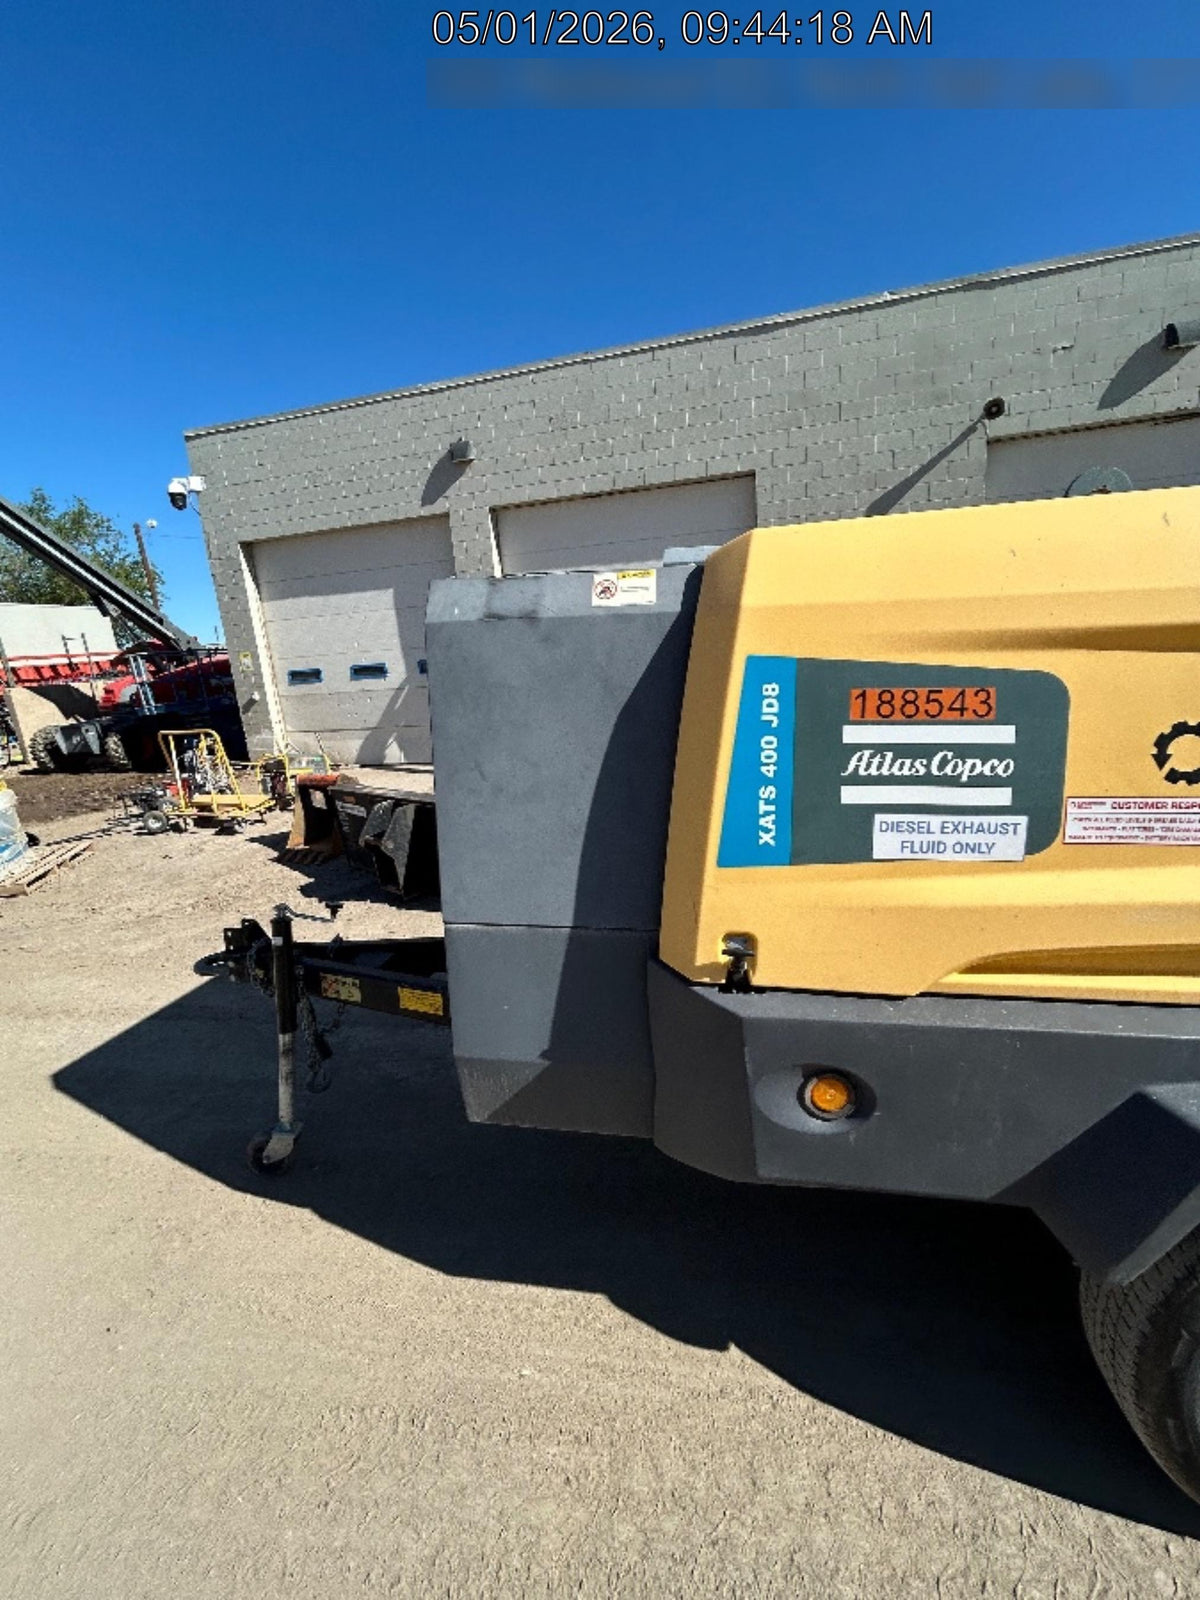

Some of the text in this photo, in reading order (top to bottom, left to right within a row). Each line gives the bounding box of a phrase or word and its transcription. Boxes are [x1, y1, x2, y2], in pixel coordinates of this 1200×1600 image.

[854, 687, 994, 719] 188543
[758, 682, 780, 847] XATS 400 JD8
[840, 749, 1015, 783] Atlas Copco
[1111, 801, 1169, 810] CUSTOMER
[1171, 801, 1200, 810] RESP
[879, 820, 1022, 836] DIESEL EXHAUST
[900, 840, 997, 855] FLUID ONLY
